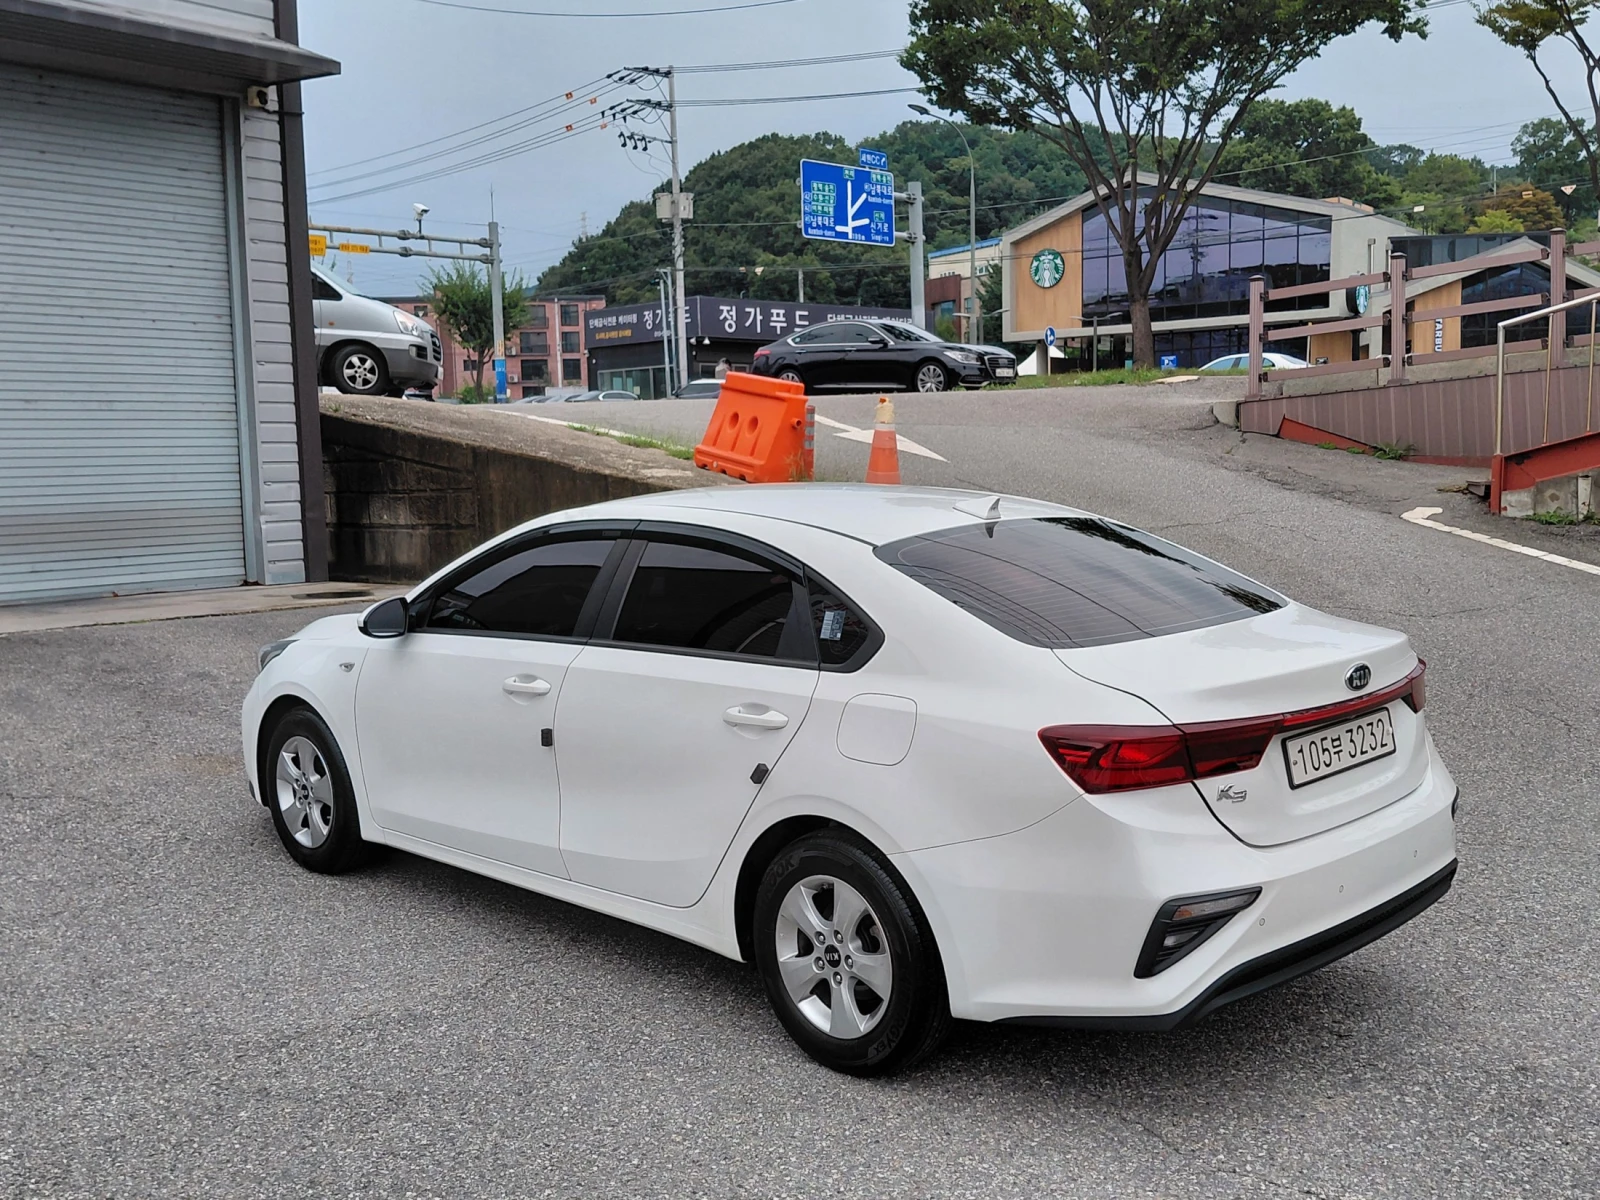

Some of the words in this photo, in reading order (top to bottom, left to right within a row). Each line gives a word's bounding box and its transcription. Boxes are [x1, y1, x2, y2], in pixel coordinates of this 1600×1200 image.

[870, 184, 892, 196] 남북대로
[810, 215, 835, 228] 남북대로
[870, 222, 889, 233] 신기로
[718, 304, 809, 334] 정가푸드
[1352, 668, 1371, 688] KIA
[1298, 734, 1343, 775] 105부
[1345, 718, 1388, 758] 3232
[1216, 783, 1247, 803] K3
[824, 951, 840, 962] KIA
